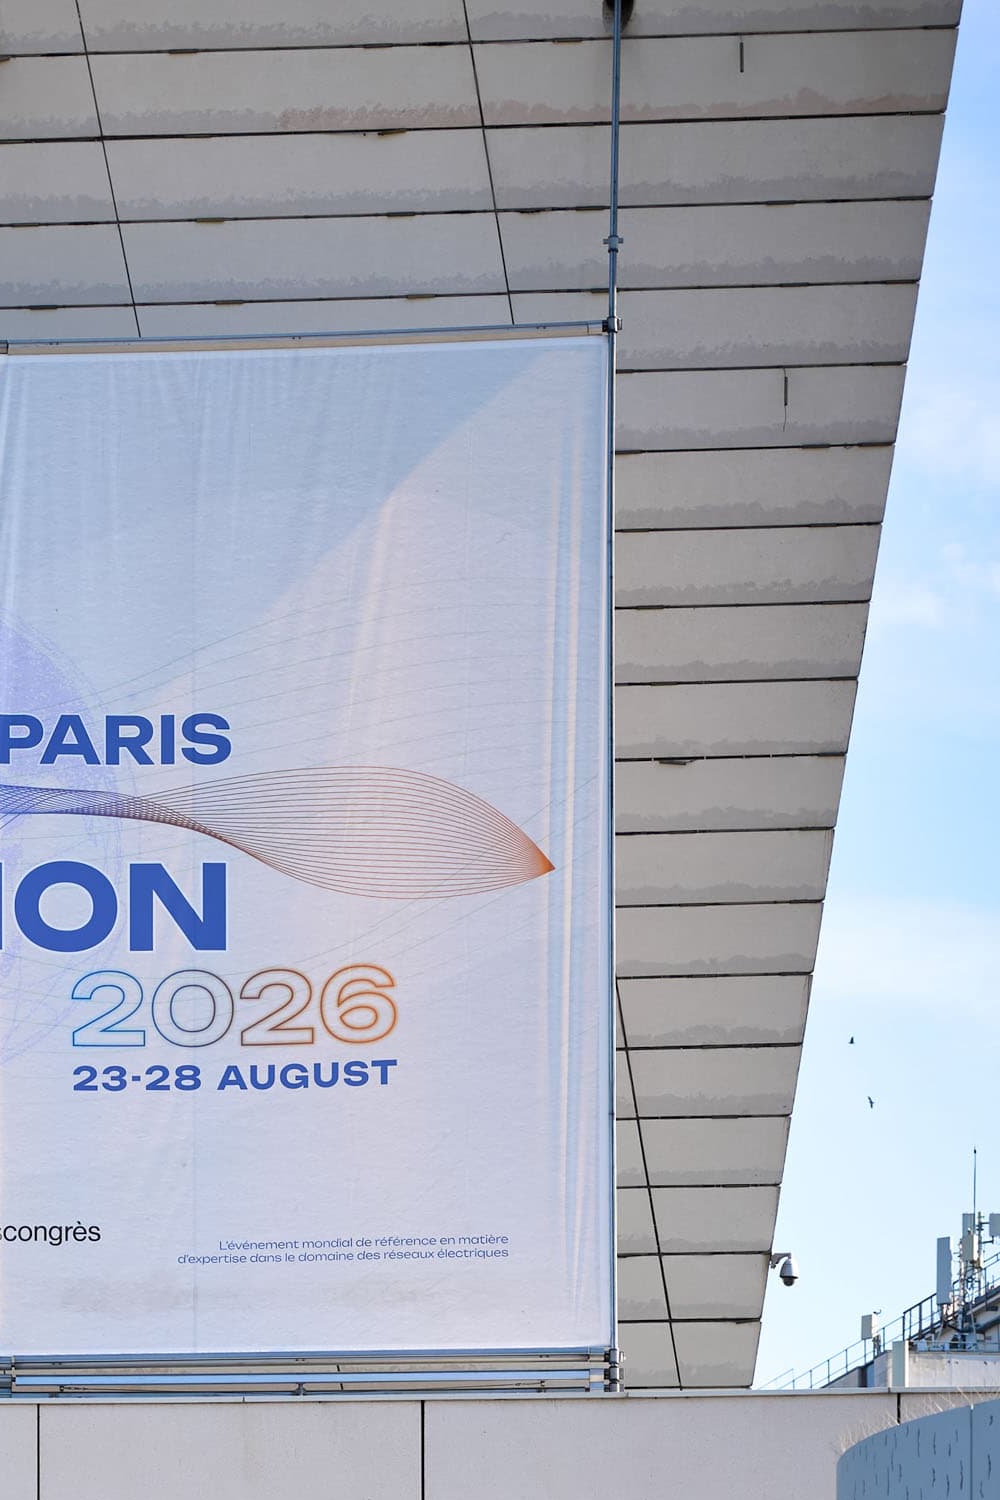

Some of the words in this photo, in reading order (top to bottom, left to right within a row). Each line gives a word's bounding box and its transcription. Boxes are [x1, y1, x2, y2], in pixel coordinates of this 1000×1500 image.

[71, 963, 397, 1048] 2026
[72, 1064, 201, 1092] 23-28
[217, 1059, 397, 1091] AUGUST
[219, 1239, 299, 1251] L'événement
[302, 1237, 353, 1249] mondial
[355, 1237, 372, 1247] de
[375, 1235, 436, 1246] référence
[439, 1237, 455, 1245] en
[458, 1234, 509, 1245] matière
[177, 1253, 247, 1265] d'expertise
[250, 1252, 282, 1263] dans
[285, 1252, 295, 1262] le
[298, 1250, 354, 1262] domaine
[357, 1250, 381, 1260] des
[383, 1249, 434, 1260] réseaux
[437, 1247, 509, 1259] électriques
